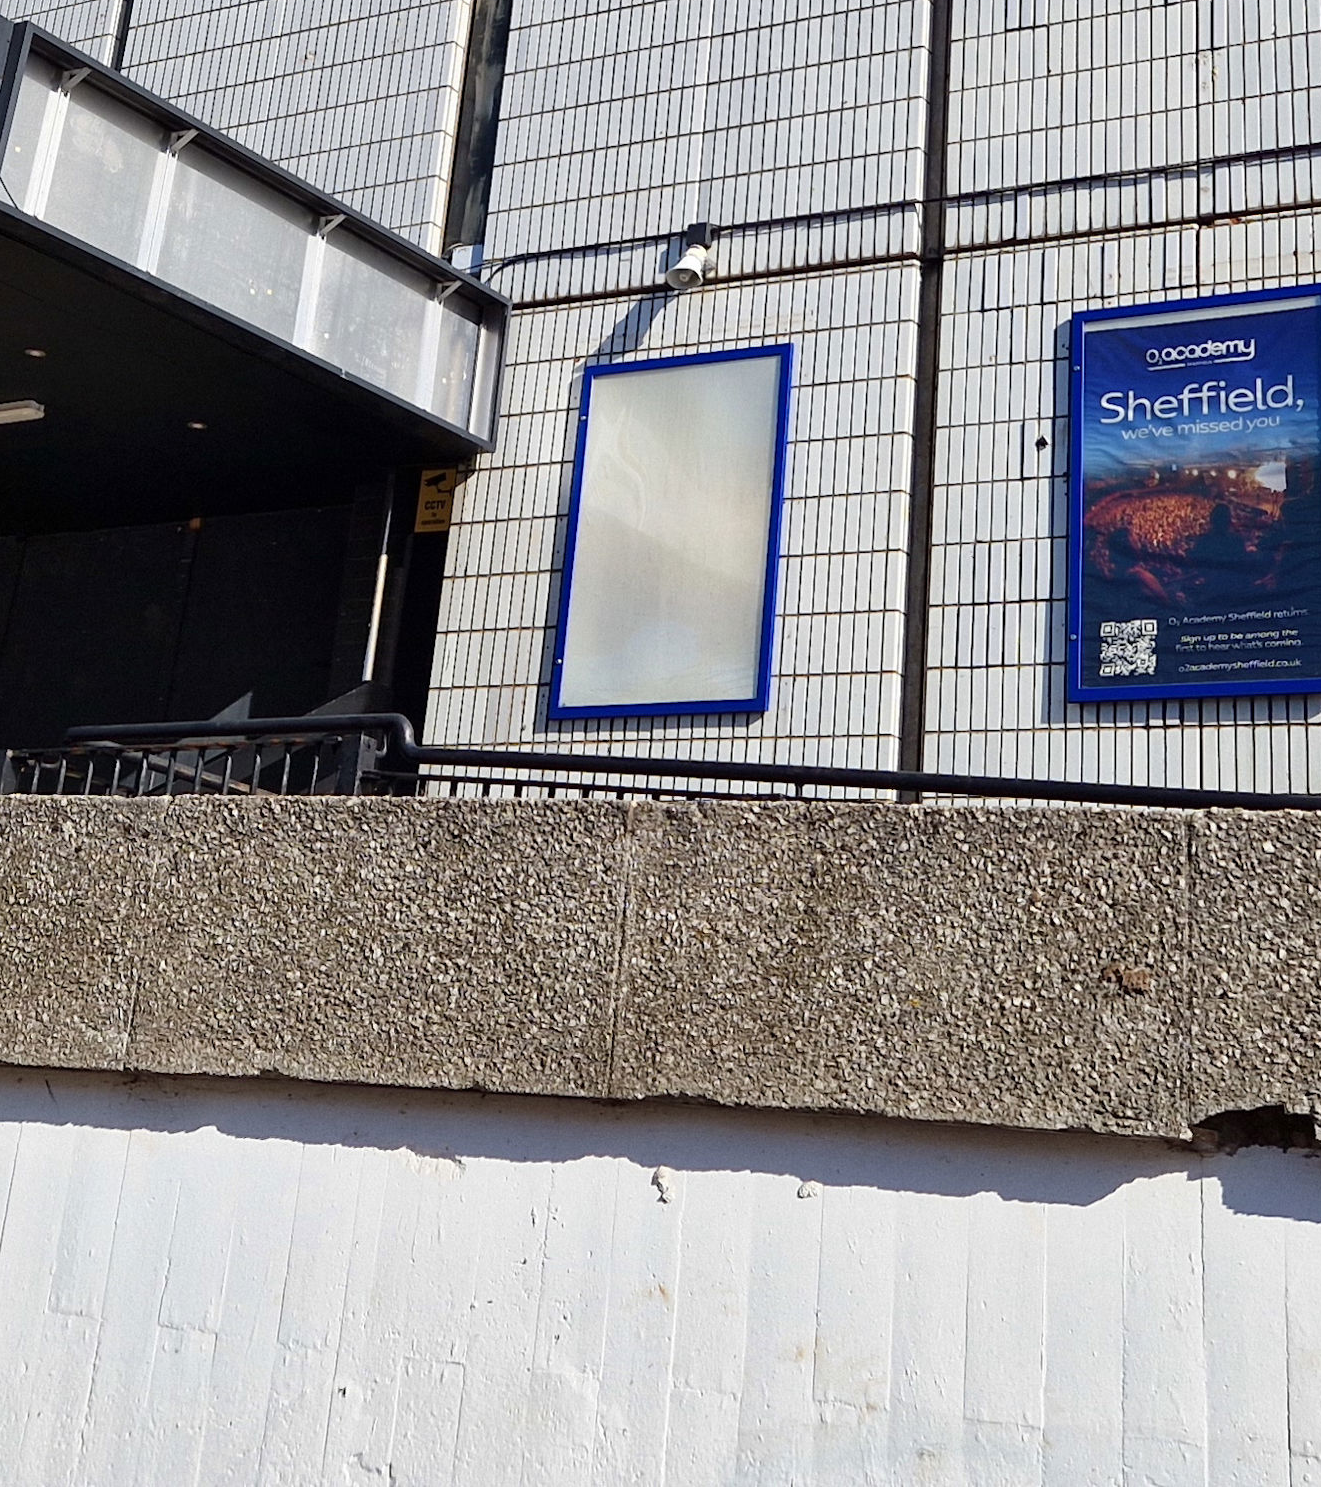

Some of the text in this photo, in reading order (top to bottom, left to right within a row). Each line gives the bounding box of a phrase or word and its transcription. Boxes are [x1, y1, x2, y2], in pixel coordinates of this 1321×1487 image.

[1100, 374, 1304, 424] Sheffield,
[1121, 415, 1280, 440] we've missed you
[424, 499, 447, 511] CCTV
[1182, 614, 1227, 625] Academy
[1227, 610, 1272, 622] Sheffield
[1203, 634, 1217, 643] up
[1217, 633, 1229, 641] to
[1230, 632, 1244, 640] be
[1244, 630, 1280, 640] among
[1281, 628, 1299, 637] the
[1195, 643, 1207, 652] to
